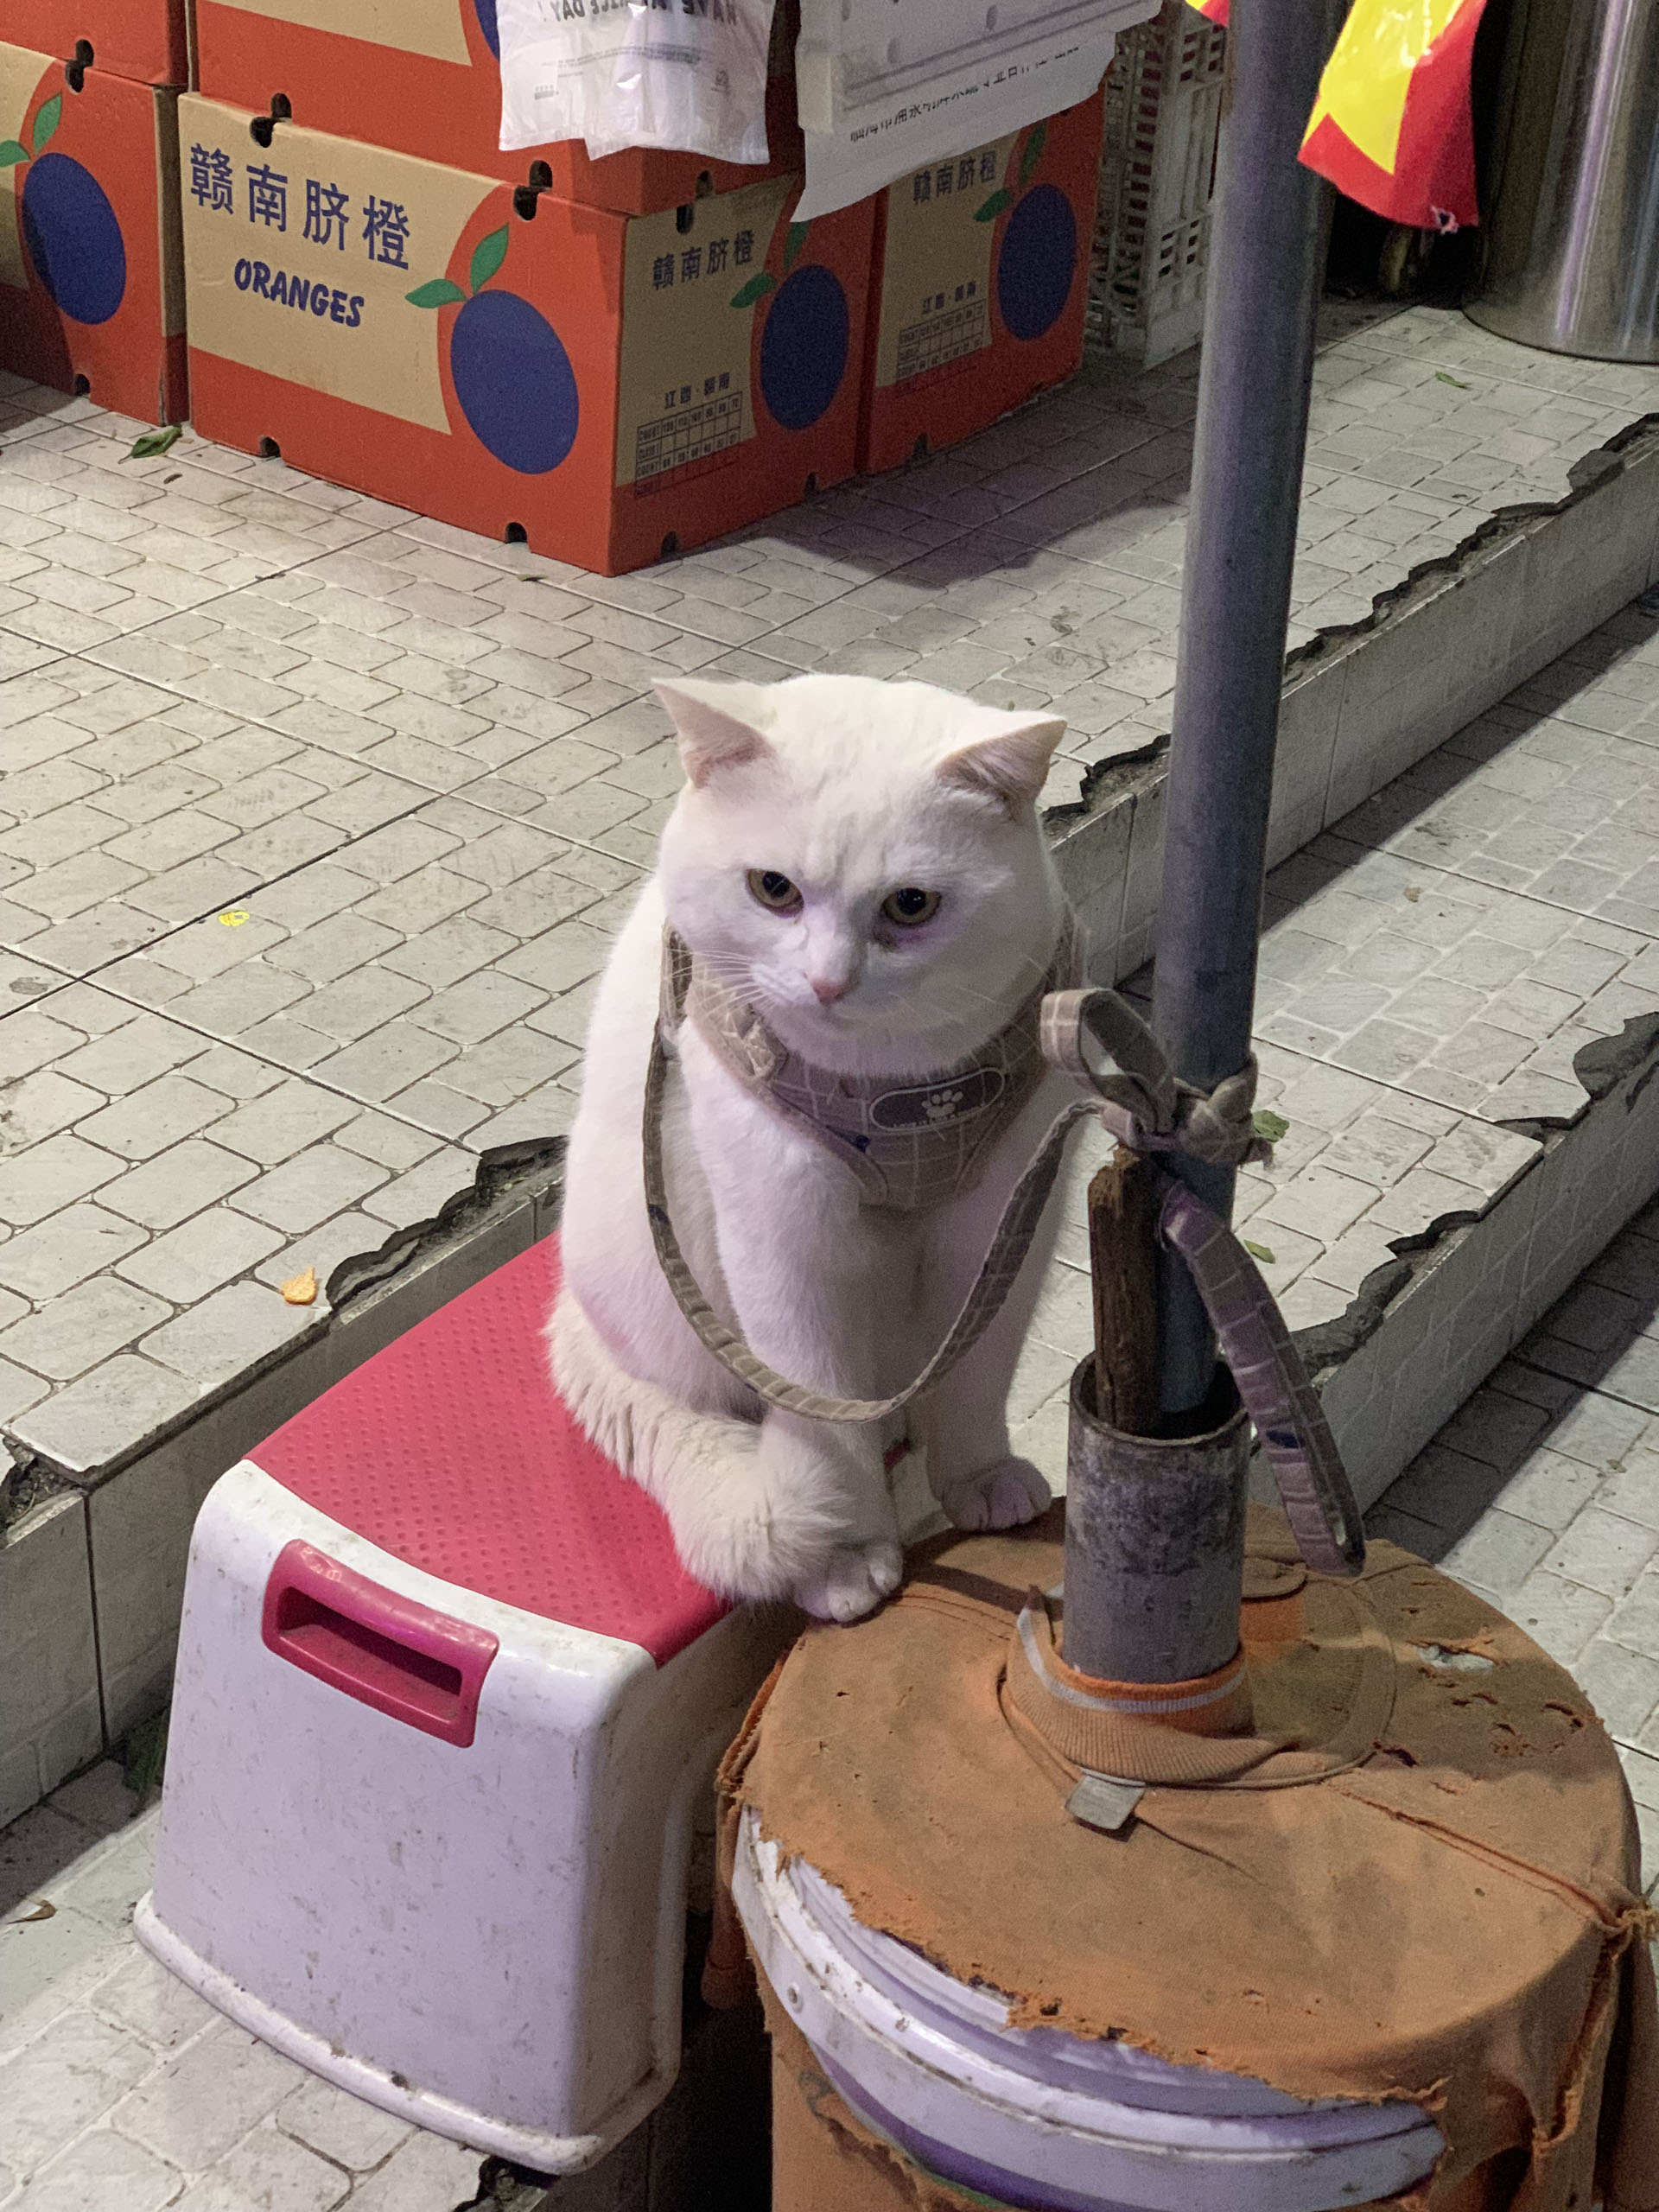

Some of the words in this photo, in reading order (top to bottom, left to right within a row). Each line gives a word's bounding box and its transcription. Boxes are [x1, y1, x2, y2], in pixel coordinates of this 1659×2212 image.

[189, 143, 411, 270] 赣南脐橙
[234, 257, 365, 327] ORANGES
[652, 229, 754, 291] 赣南脐橙
